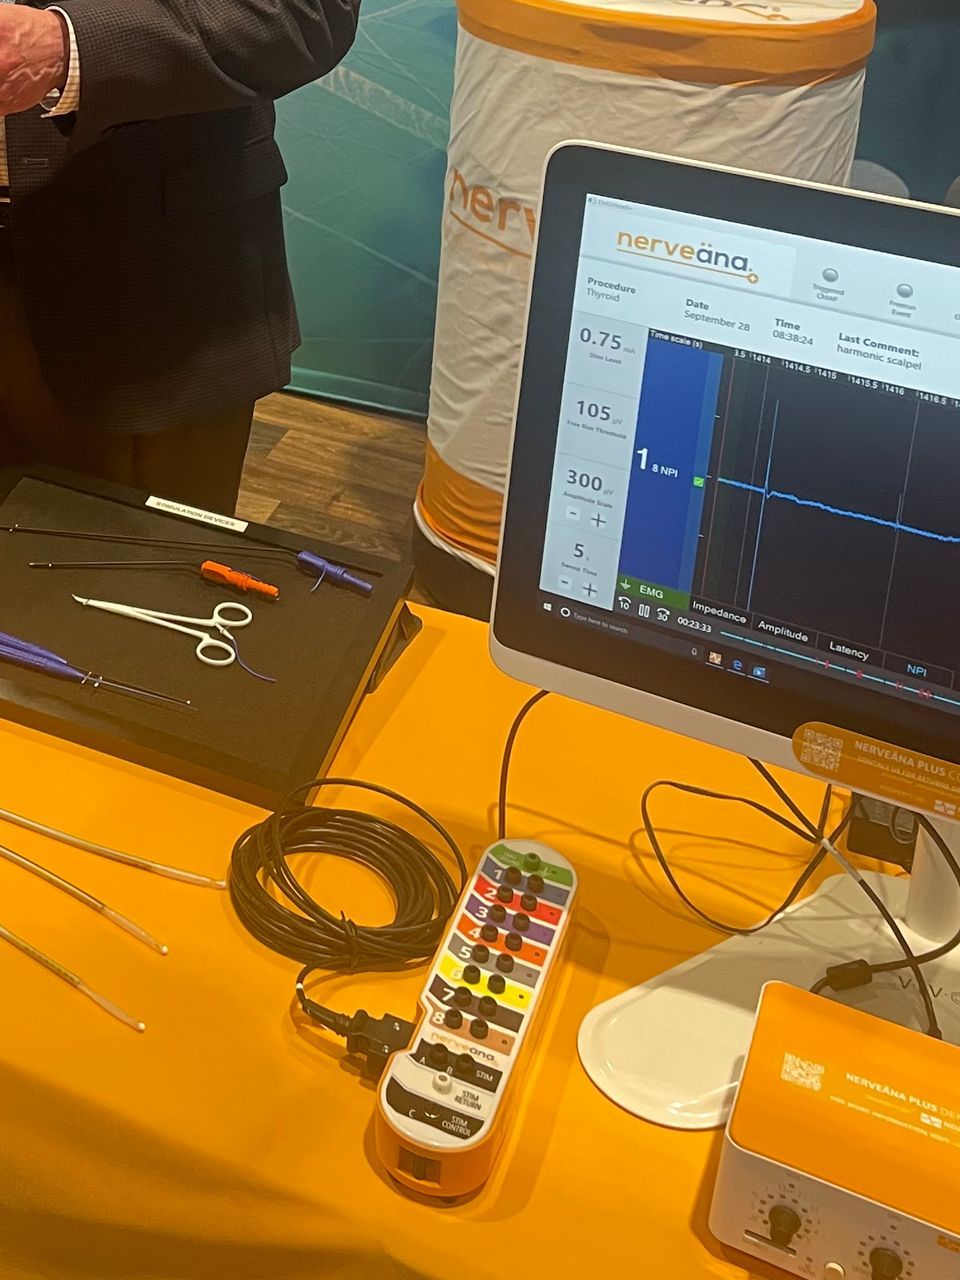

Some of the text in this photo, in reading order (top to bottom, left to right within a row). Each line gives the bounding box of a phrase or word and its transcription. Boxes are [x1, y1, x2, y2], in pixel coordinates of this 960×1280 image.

[587, 276, 637, 294] Procedure
[586, 287, 620, 303] Thyroid
[686, 298, 710, 311] Date
[684, 310, 751, 332] September 28
[775, 318, 801, 331] Time
[580, 327, 622, 350] 0.75
[649, 330, 670, 341] Time
[671, 336, 692, 347] scale
[772, 330, 814, 346] 08:38:24
[838, 333, 920, 358] Last Comment:
[837, 344, 922, 370] harmonic scalpel
[752, 353, 771, 364] 1414
[785, 360, 811, 374] 1414.5
[818, 368, 837, 380] 1415
[851, 376, 878, 389] 1415.5
[885, 384, 905, 396] 1416
[577, 400, 611, 421] 105
[636, 448, 648, 470] 1
[660, 466, 678, 478] NPI
[566, 469, 603, 492] 300
[573, 543, 584, 558] 5
[639, 584, 664, 599] EMG
[619, 601, 630, 610] 10
[657, 612, 668, 622] 30
[692, 600, 747, 624] Impedance
[758, 620, 809, 642] Amplitude
[829, 641, 869, 662] Latency
[907, 663, 927, 677] NPI
[917, 760, 945, 776] PLUS
[493, 869, 503, 880] 1
[484, 888, 497, 900] 2
[475, 906, 489, 919] 3
[468, 927, 480, 939] 4
[458, 946, 472, 959] 5
[442, 987, 455, 1001] 7
[432, 1012, 445, 1024] 8
[419, 1056, 426, 1065] A
[475, 1070, 494, 1082] STIM
[454, 1095, 482, 1110] RETURN
[463, 1090, 479, 1102] STIM
[909, 1095, 938, 1112] PLUS
[408, 1109, 416, 1118] C
[451, 1115, 468, 1127] STIM
[441, 1120, 471, 1136] CONTROL
